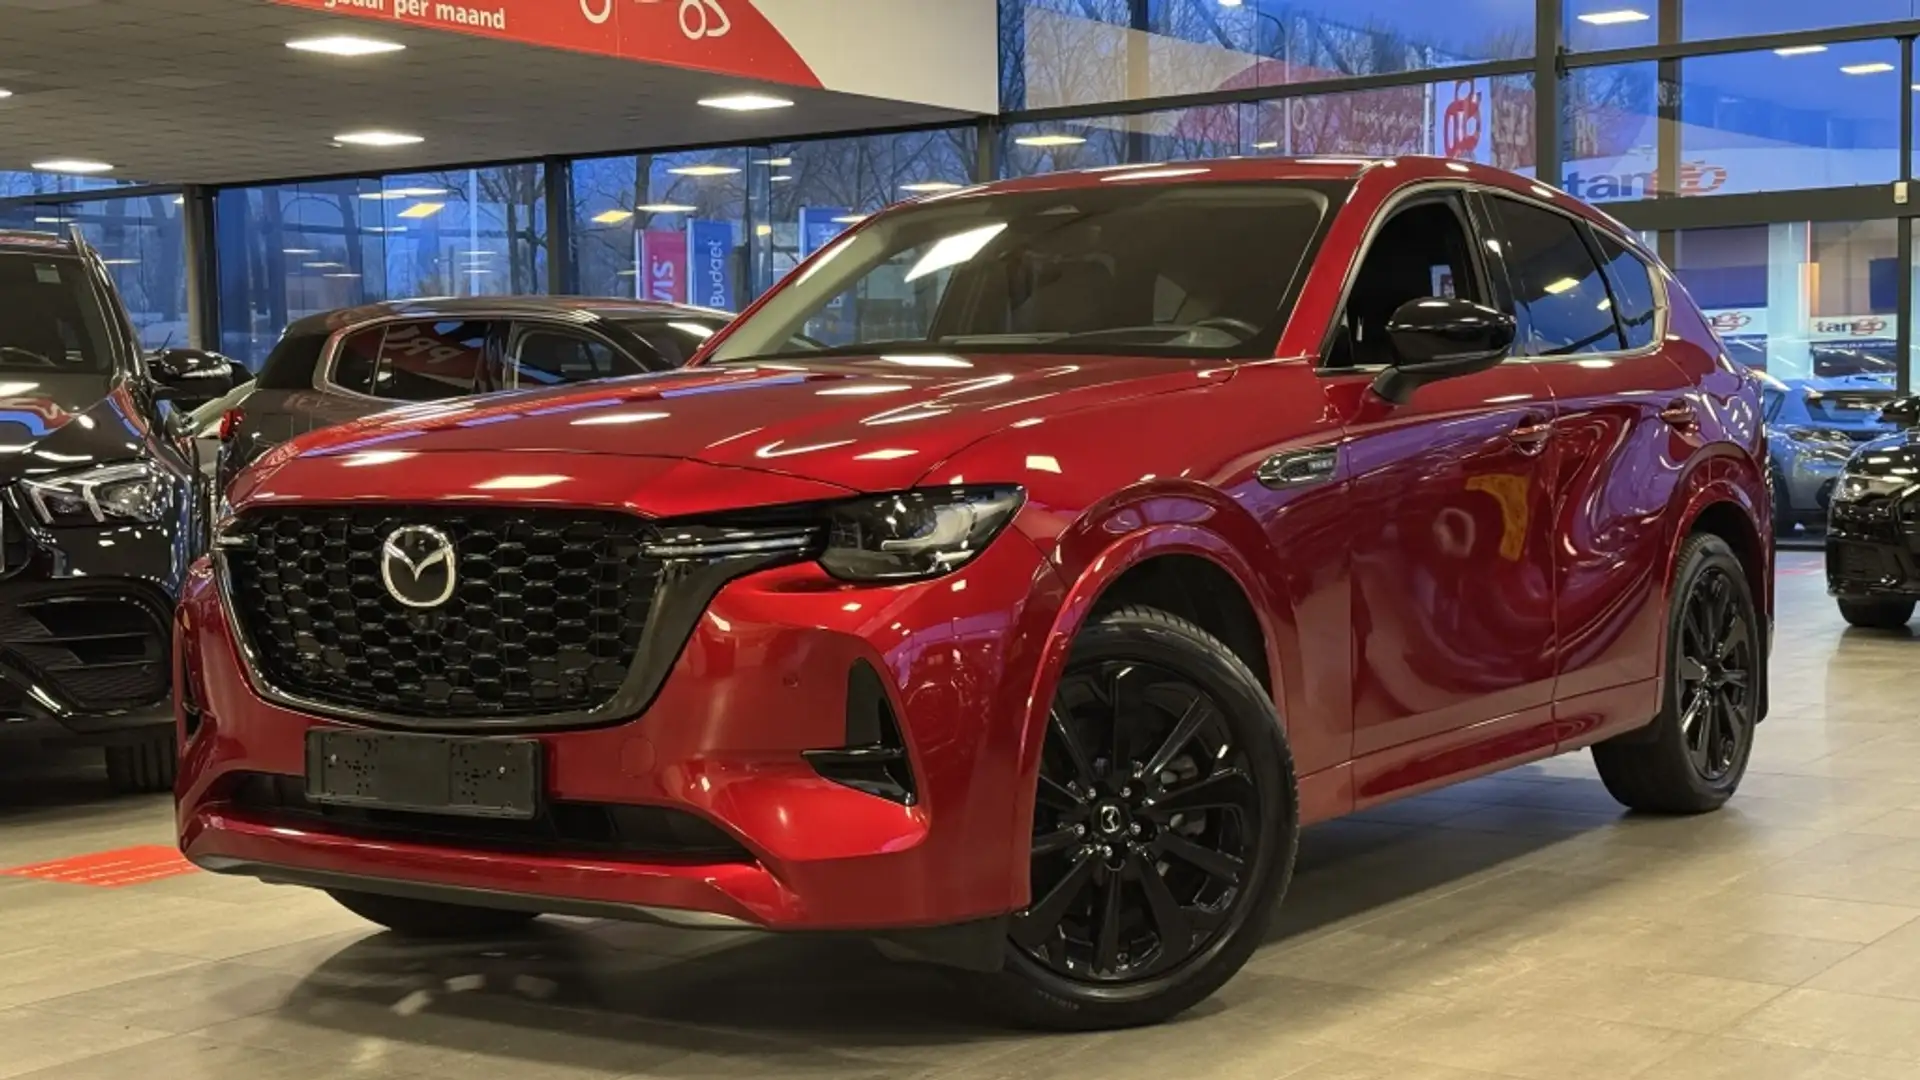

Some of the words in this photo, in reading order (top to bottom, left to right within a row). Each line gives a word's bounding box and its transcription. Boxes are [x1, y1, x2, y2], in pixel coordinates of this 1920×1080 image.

[393, 0, 429, 19] per
[435, 3, 506, 30] maand
[707, 239, 725, 307] Budget
